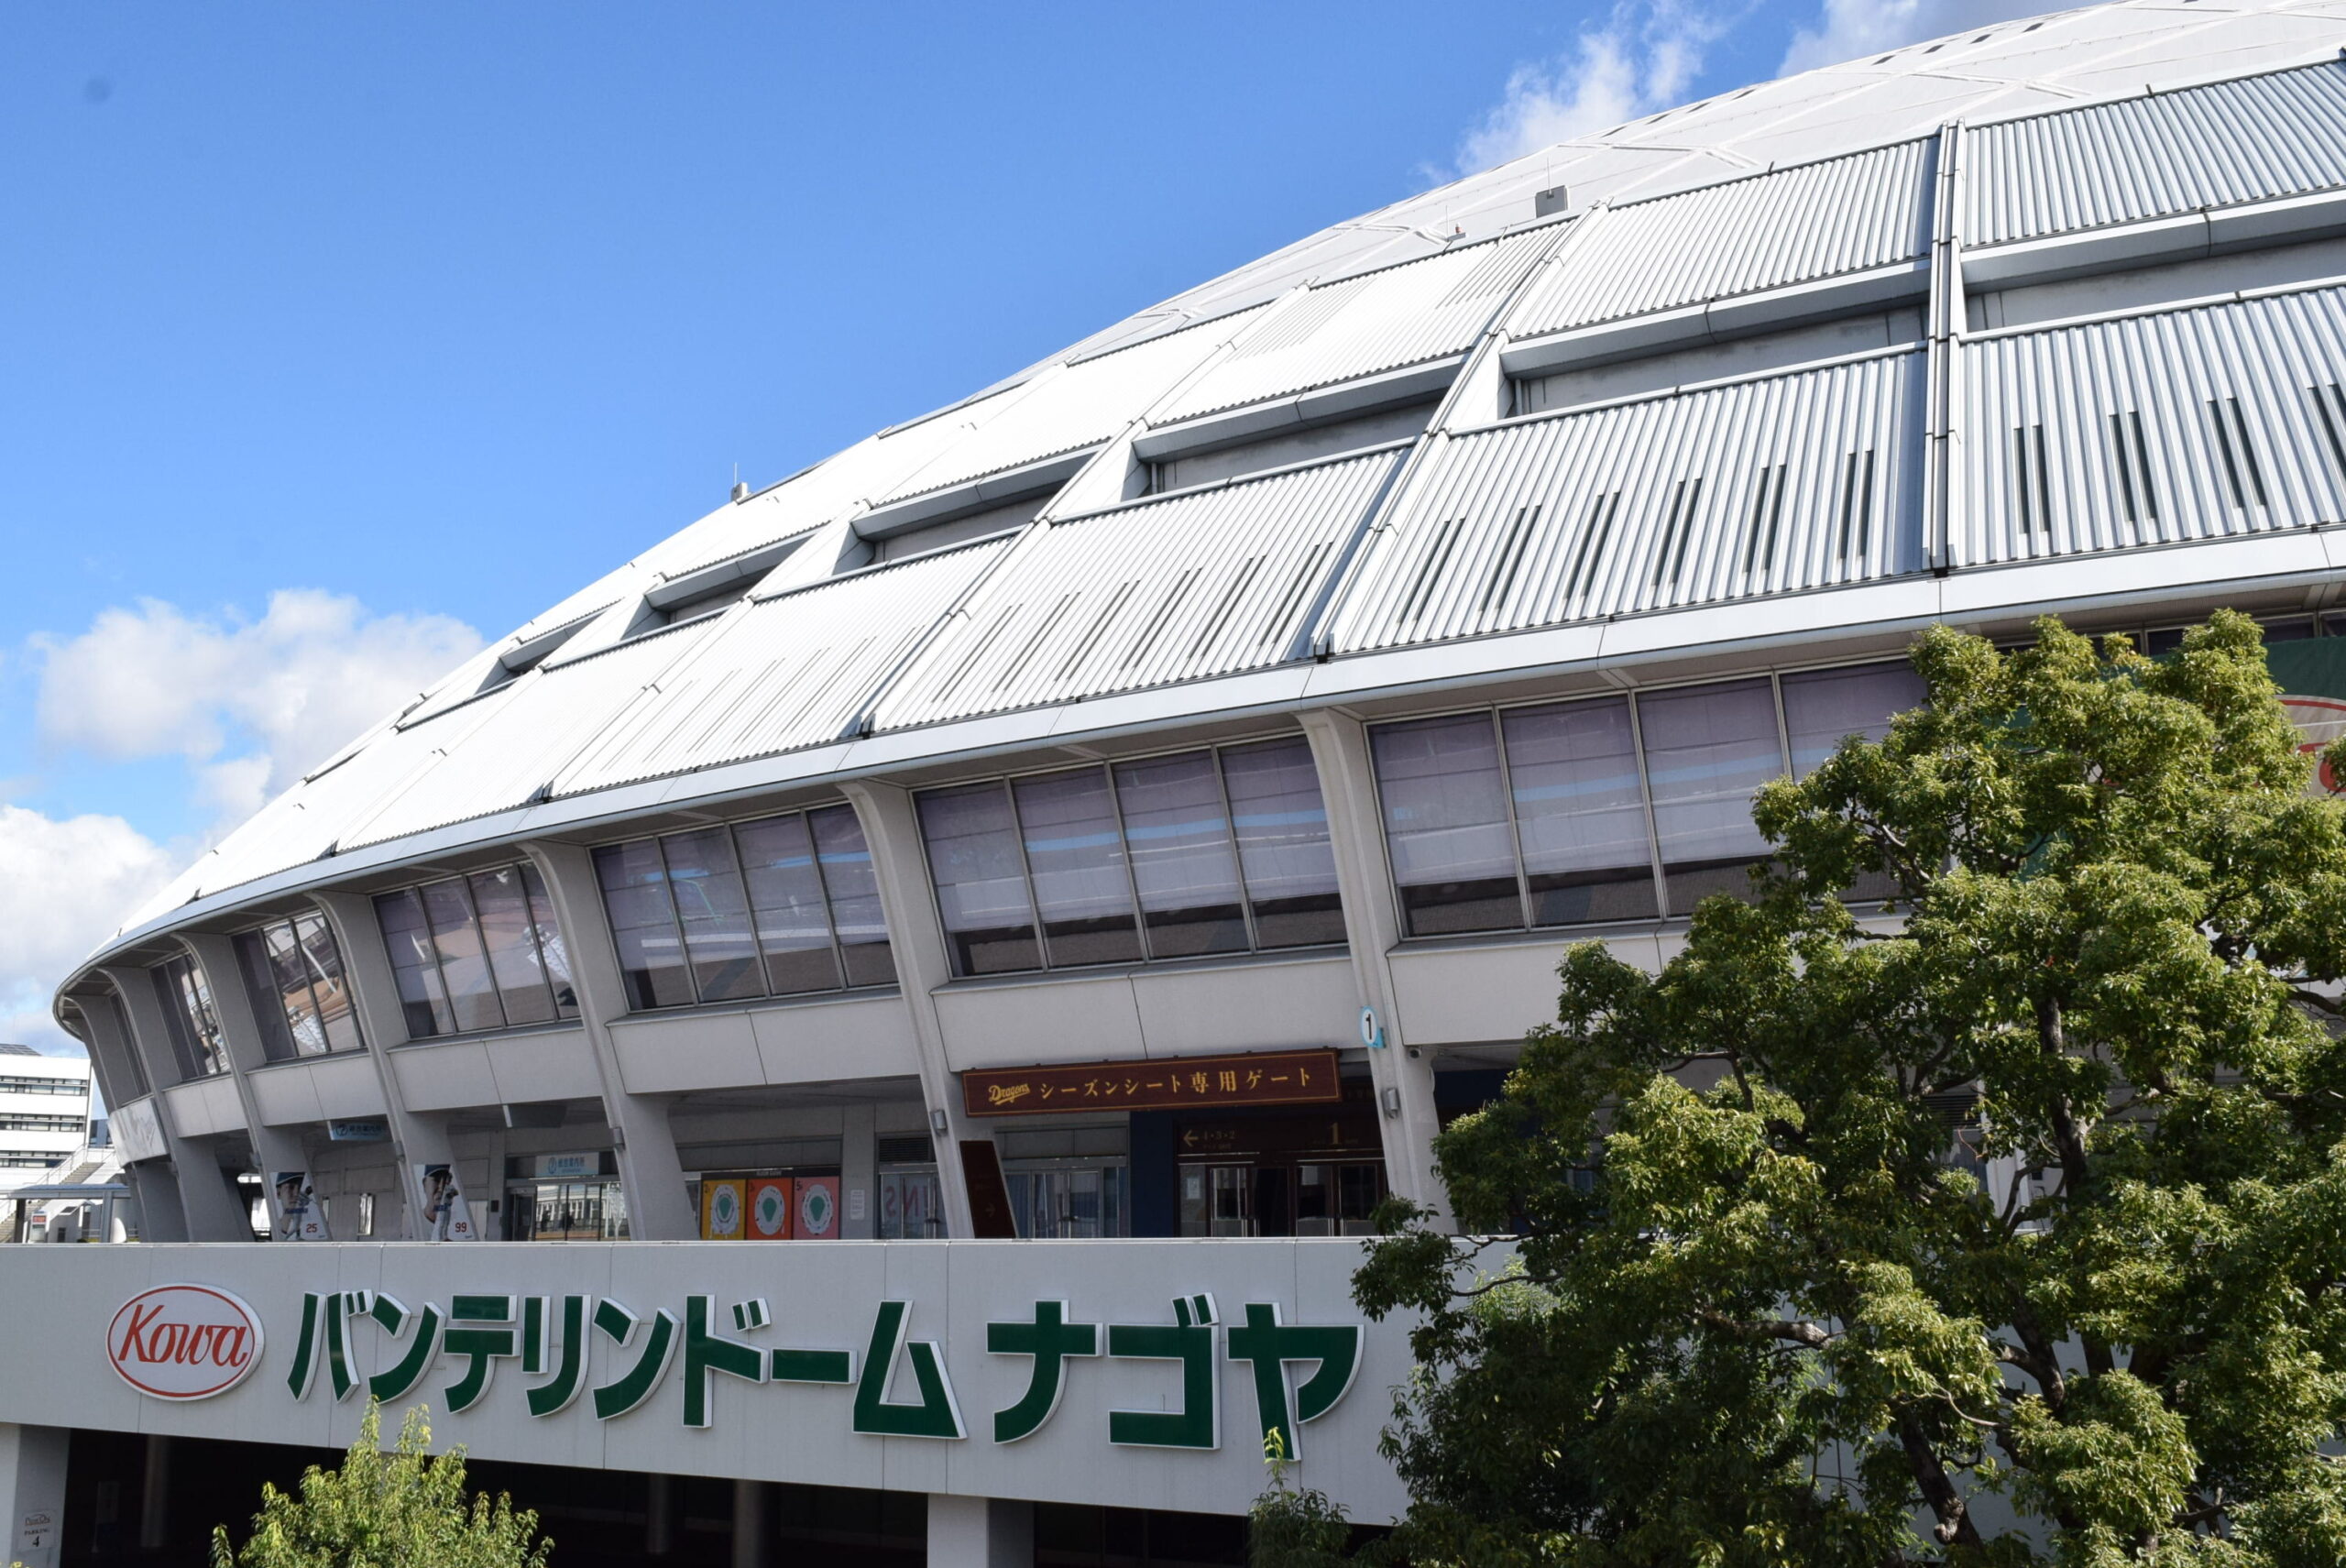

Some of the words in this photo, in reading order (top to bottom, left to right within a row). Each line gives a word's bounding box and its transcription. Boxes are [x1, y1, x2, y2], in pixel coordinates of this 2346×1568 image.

[1365, 1013, 1373, 1040] 1
[988, 1083, 1031, 1105] Dragons
[1040, 1067, 1311, 1099] シーズンシート専用ゲート
[306, 1223, 318, 1234] 25
[455, 1222, 467, 1233] 99
[117, 1303, 248, 1368] Kowa
[286, 1288, 967, 1440] バンテリンドーム
[986, 1292, 1365, 1462] ナゴヤ
[32, 1535, 40, 1547] 4
